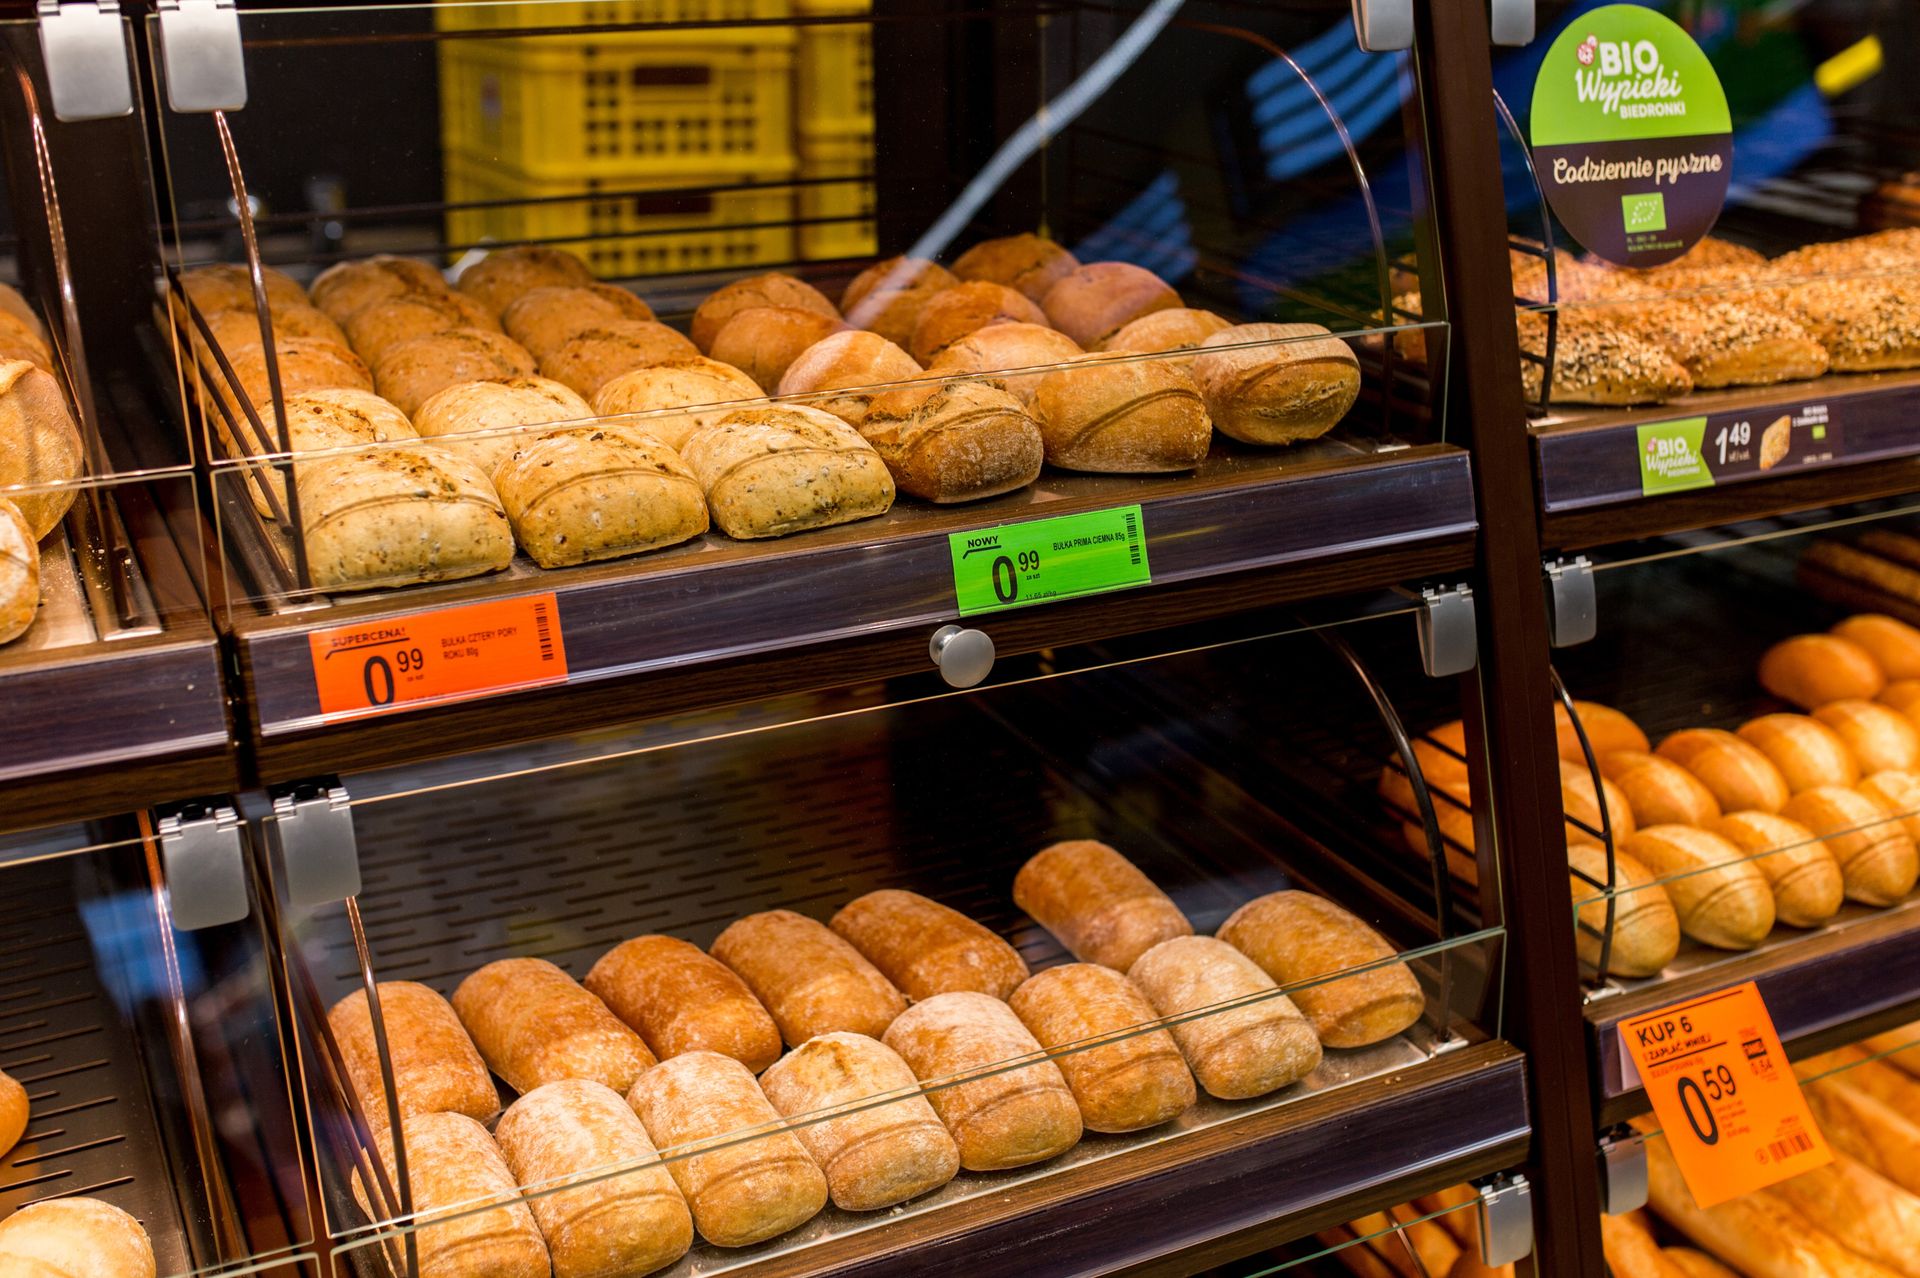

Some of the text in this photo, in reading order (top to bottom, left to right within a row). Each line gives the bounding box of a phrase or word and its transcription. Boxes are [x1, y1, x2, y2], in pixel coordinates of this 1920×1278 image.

[1600, 40, 1659, 76] BIO
[1575, 63, 1682, 115] Wypieki
[1620, 101, 1686, 119] BIEDRONKI
[1553, 152, 1723, 186] Codziennie pyszne
[1657, 436, 1687, 458] BIO
[967, 535, 999, 549] NOWY
[1073, 537, 1092, 547] PRIMA
[1092, 533, 1115, 545] CIEMNA
[331, 627, 406, 647] SUPERCENA!
[1636, 1016, 1693, 1047] KUP 6
